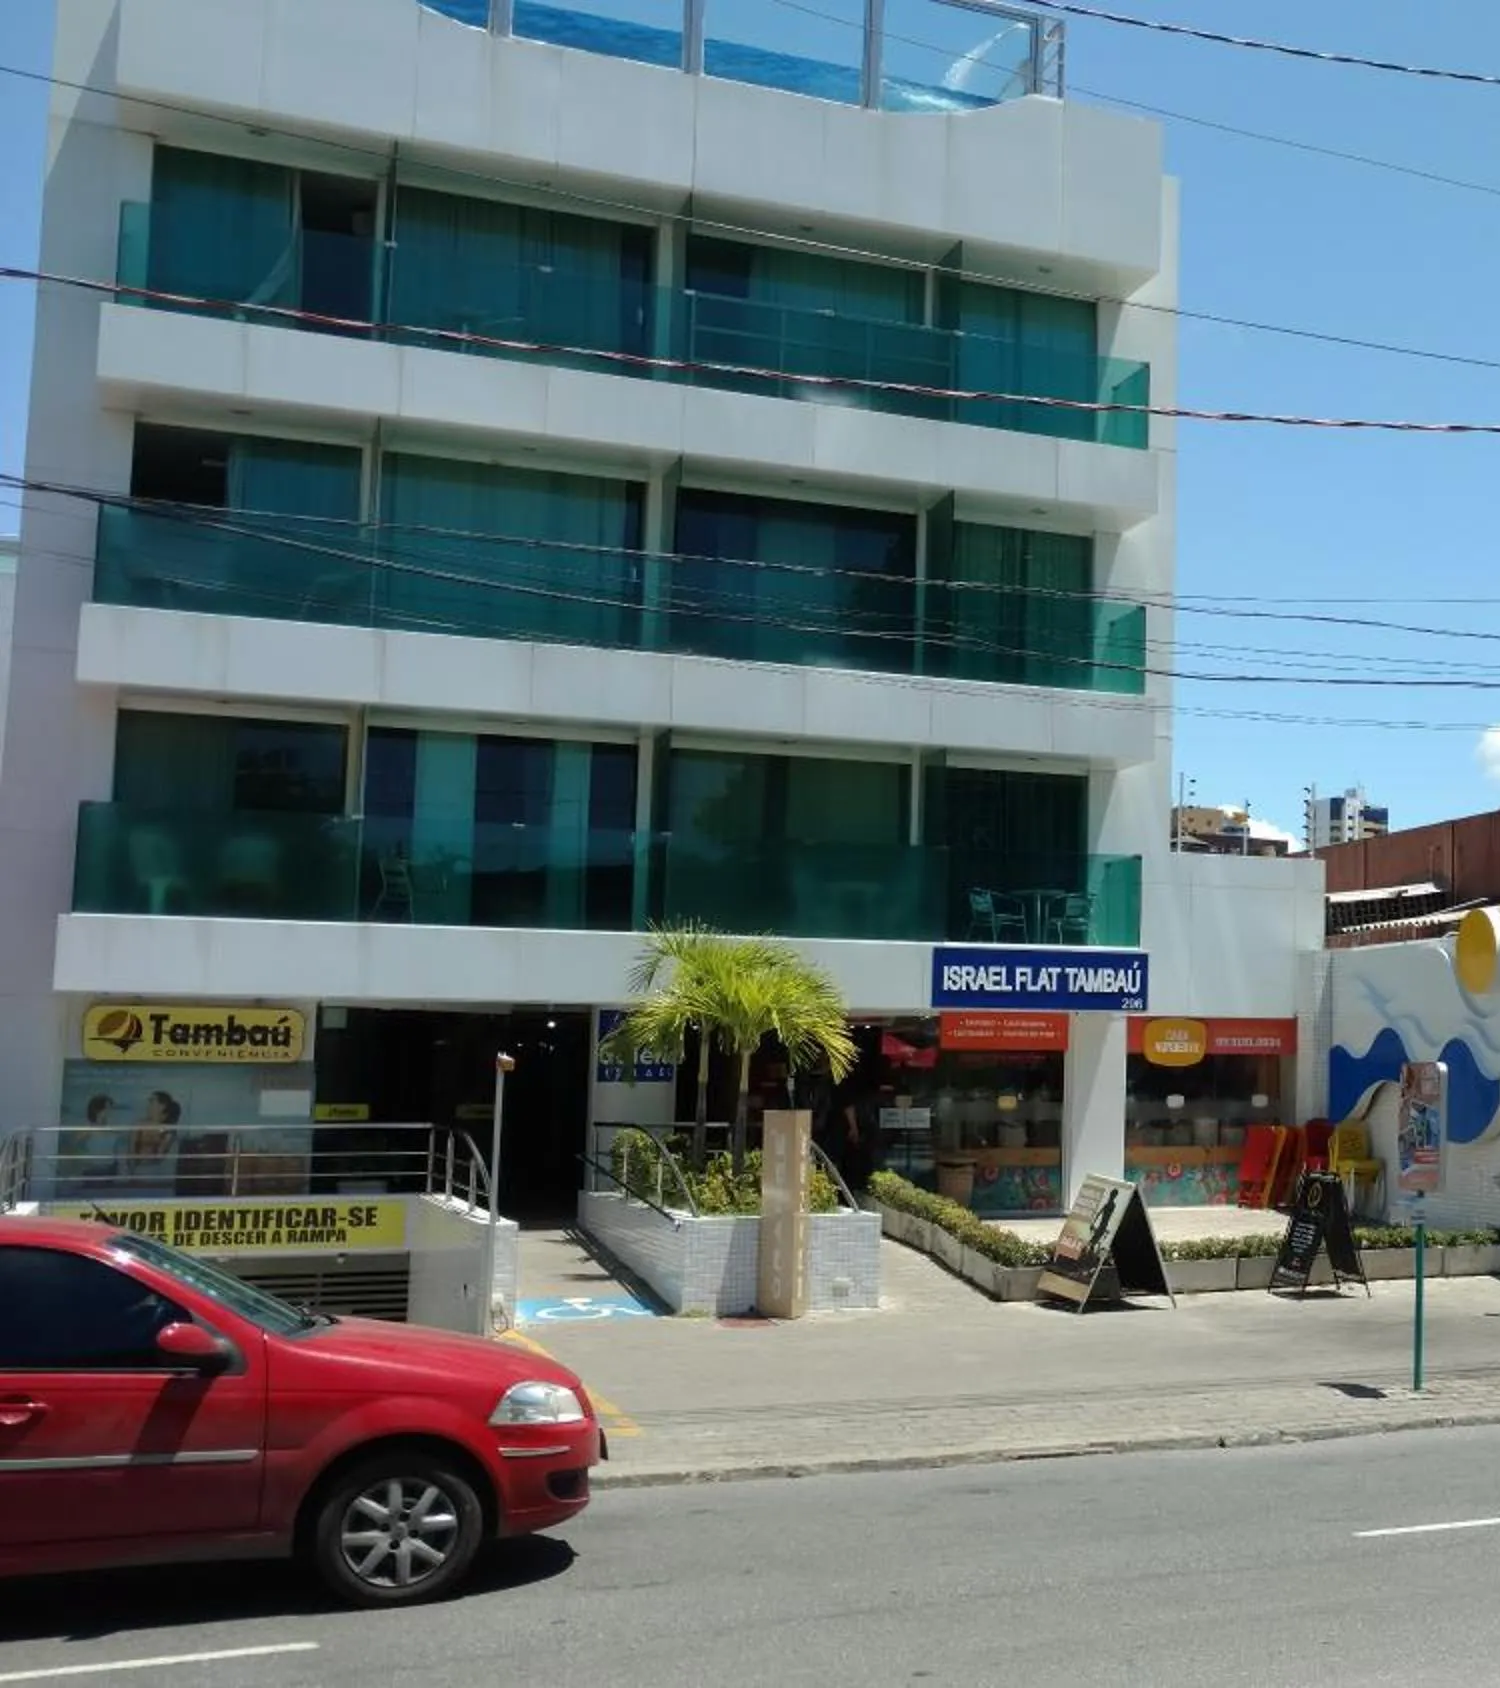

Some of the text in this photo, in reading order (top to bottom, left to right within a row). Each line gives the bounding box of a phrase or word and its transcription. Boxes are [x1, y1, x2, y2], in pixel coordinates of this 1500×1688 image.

[943, 961, 1141, 994] ISRAEL FLAT TAMBAÚ
[149, 1014, 292, 1047] Tambaú
[174, 1206, 379, 1231] IDENTIFICAR-SE
[173, 1232, 195, 1247] DE
[200, 1230, 269, 1246] DESCER
[272, 1230, 283, 1243] A
[287, 1228, 347, 1243] RAMPA
